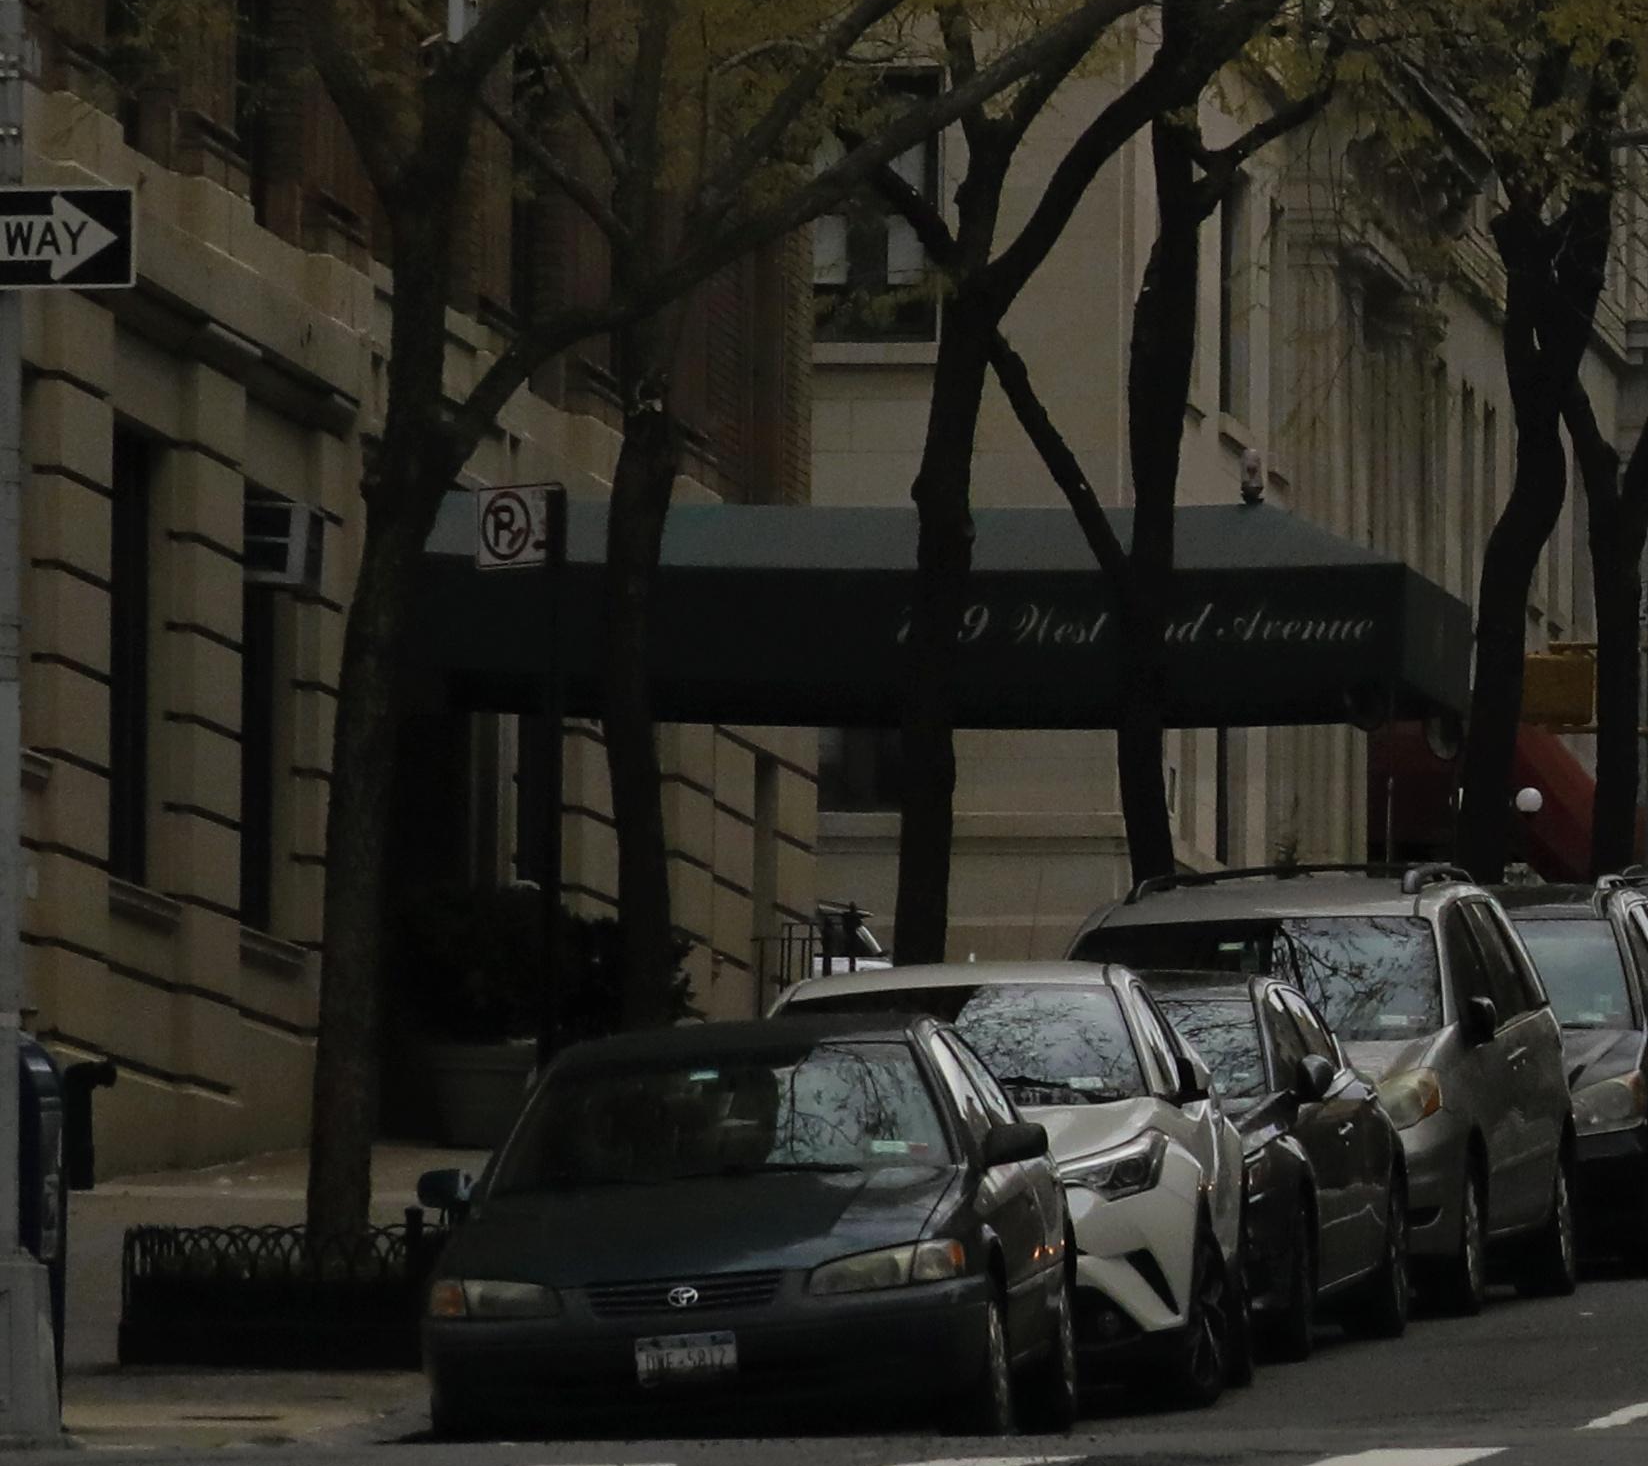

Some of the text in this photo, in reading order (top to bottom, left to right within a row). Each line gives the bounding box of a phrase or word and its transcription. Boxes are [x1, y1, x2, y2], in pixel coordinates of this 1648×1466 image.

[5, 221, 88, 256] WAY
[1013, 601, 1110, 645] West
[1216, 598, 1375, 643] Avenue
